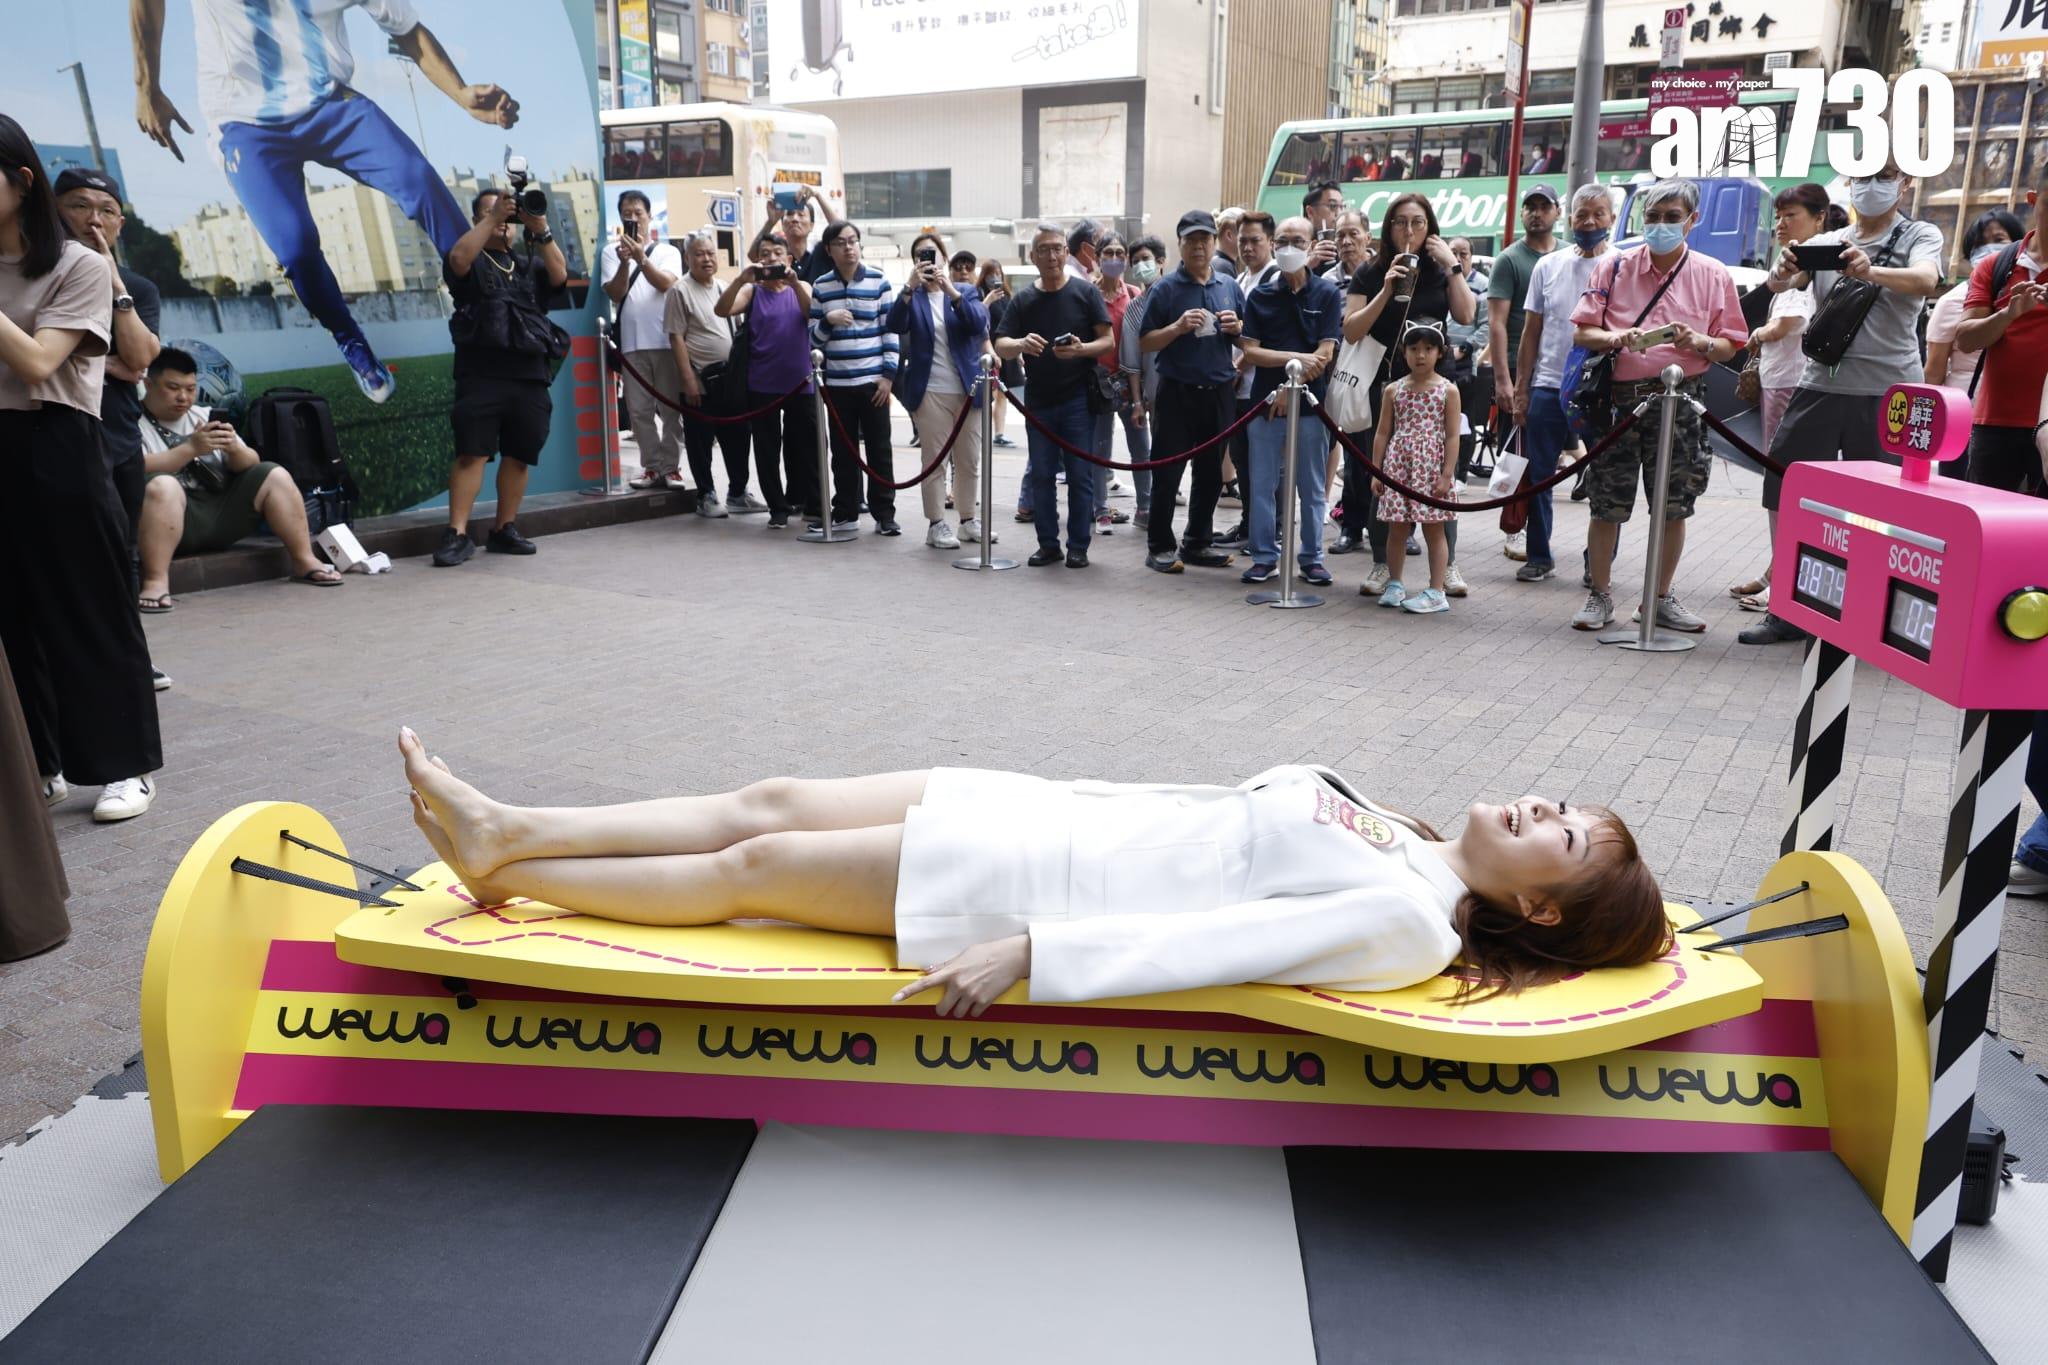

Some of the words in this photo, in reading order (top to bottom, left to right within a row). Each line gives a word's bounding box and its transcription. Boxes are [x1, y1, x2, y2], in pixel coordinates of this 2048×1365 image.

[1629, 13, 1777, 48] 鼎同鄉會
[721, 203, 732, 220] P
[1823, 522, 1850, 553] TIME
[1888, 544, 1943, 585] SCORE
[277, 1005, 451, 1046] wewa
[486, 1014, 663, 1056] wewa
[698, 1024, 878, 1067] wewa
[914, 1034, 1099, 1077] wewa
[1136, 1043, 1326, 1087] wewa
[1597, 1063, 1803, 1110] wewa
